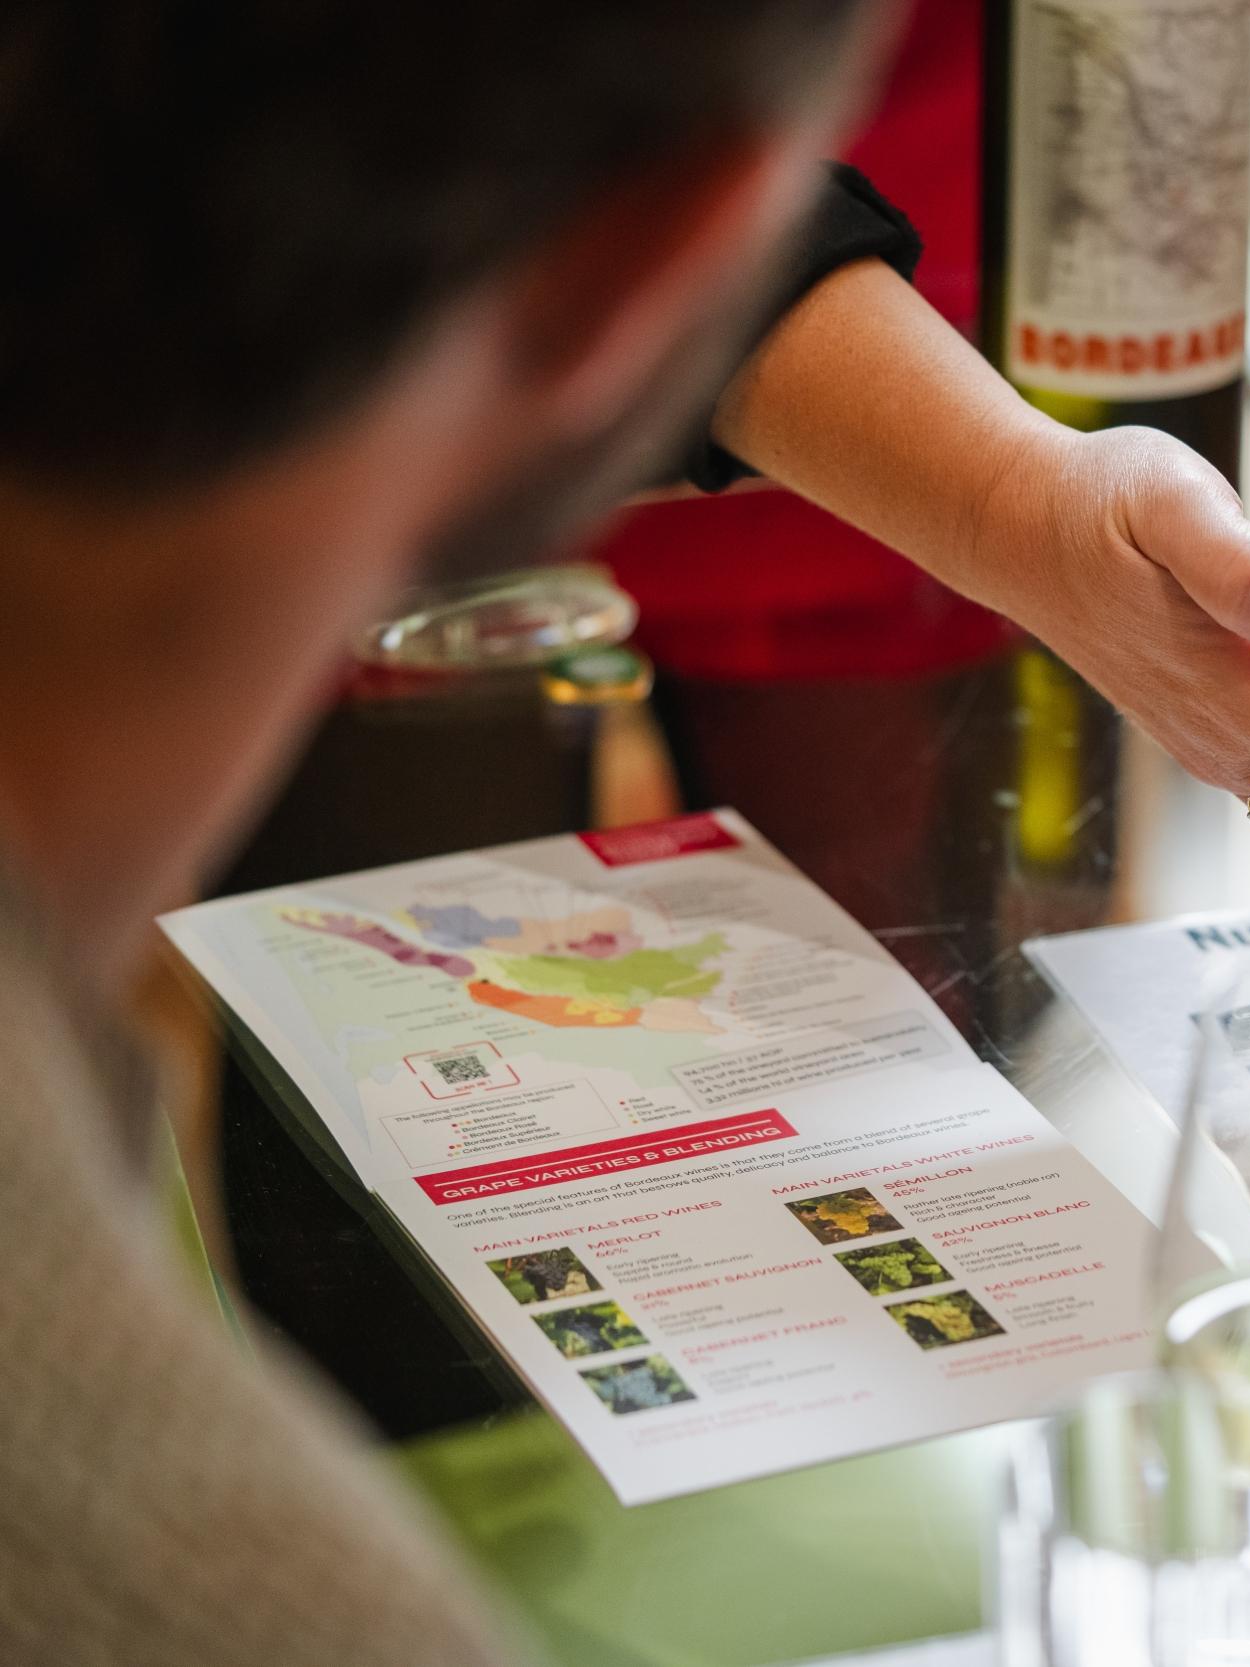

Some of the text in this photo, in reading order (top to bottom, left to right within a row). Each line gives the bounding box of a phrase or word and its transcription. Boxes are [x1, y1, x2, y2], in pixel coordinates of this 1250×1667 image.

[472, 1111, 517, 1124] Bordeaux
[485, 1100, 526, 1114] Bordeaux
[461, 1120, 506, 1133] Bordeaux
[469, 1126, 513, 1139] Bordeaux
[516, 1130, 561, 1144] Bordeaux
[463, 1134, 508, 1148] Bordeaux
[442, 1126, 783, 1199] GRAPE VARIETIES & BLENDING
[447, 1213, 473, 1222] One
[475, 1208, 488, 1218] of
[489, 1204, 511, 1215] the
[513, 1195, 555, 1212] special
[557, 1186, 609, 1201] features
[610, 1182, 623, 1191] of
[624, 1172, 682, 1189] Bordeaux
[683, 1164, 720, 1178] wines
[720, 1161, 731, 1170] is
[732, 1156, 758, 1168] that
[759, 1150, 786, 1164] they
[787, 1143, 823, 1155] come
[823, 1137, 856, 1149] from
[865, 1127, 899, 1140] blend
[899, 1124, 912, 1134] of
[914, 1115, 955, 1129] several
[956, 1108, 991, 1120] grape
[772, 1133, 1037, 1195] MAIN VARIETALS WHITE WINES
[453, 1215, 507, 1229] varieties.
[508, 1203, 562, 1219] Blending
[563, 1200, 574, 1209] is
[575, 1197, 592, 1206] an
[592, 1193, 611, 1204] art
[612, 1188, 638, 1200] that
[638, 1179, 691, 1194] bestows
[691, 1169, 735, 1184] quality,
[735, 1159, 786, 1175] delicacy
[786, 1153, 811, 1165] and
[811, 1144, 861, 1160] balance
[861, 1140, 875, 1150] to
[875, 1130, 933, 1147] Bordeaux
[882, 1166, 974, 1192] SÉMILLON
[903, 1171, 1061, 1211] Rather late ripening (noble rot)
[892, 1186, 926, 1199] 45%
[909, 1206, 935, 1218] Rich
[944, 1193, 997, 1212] character
[915, 1192, 1033, 1224] Good ageing potential
[473, 1200, 723, 1254] MAIN VARIETALS RED WINES
[931, 1200, 1092, 1240] SAUVIGNON BLANC
[586, 1229, 662, 1251] MERLOT
[981, 1240, 1025, 1257] ripening
[636, 1250, 680, 1266] ripening
[958, 1251, 1013, 1268] Freshness
[632, 1256, 824, 1303] CABERNET SAUVIGNON
[984, 1261, 1107, 1293] MUSCADELLE
